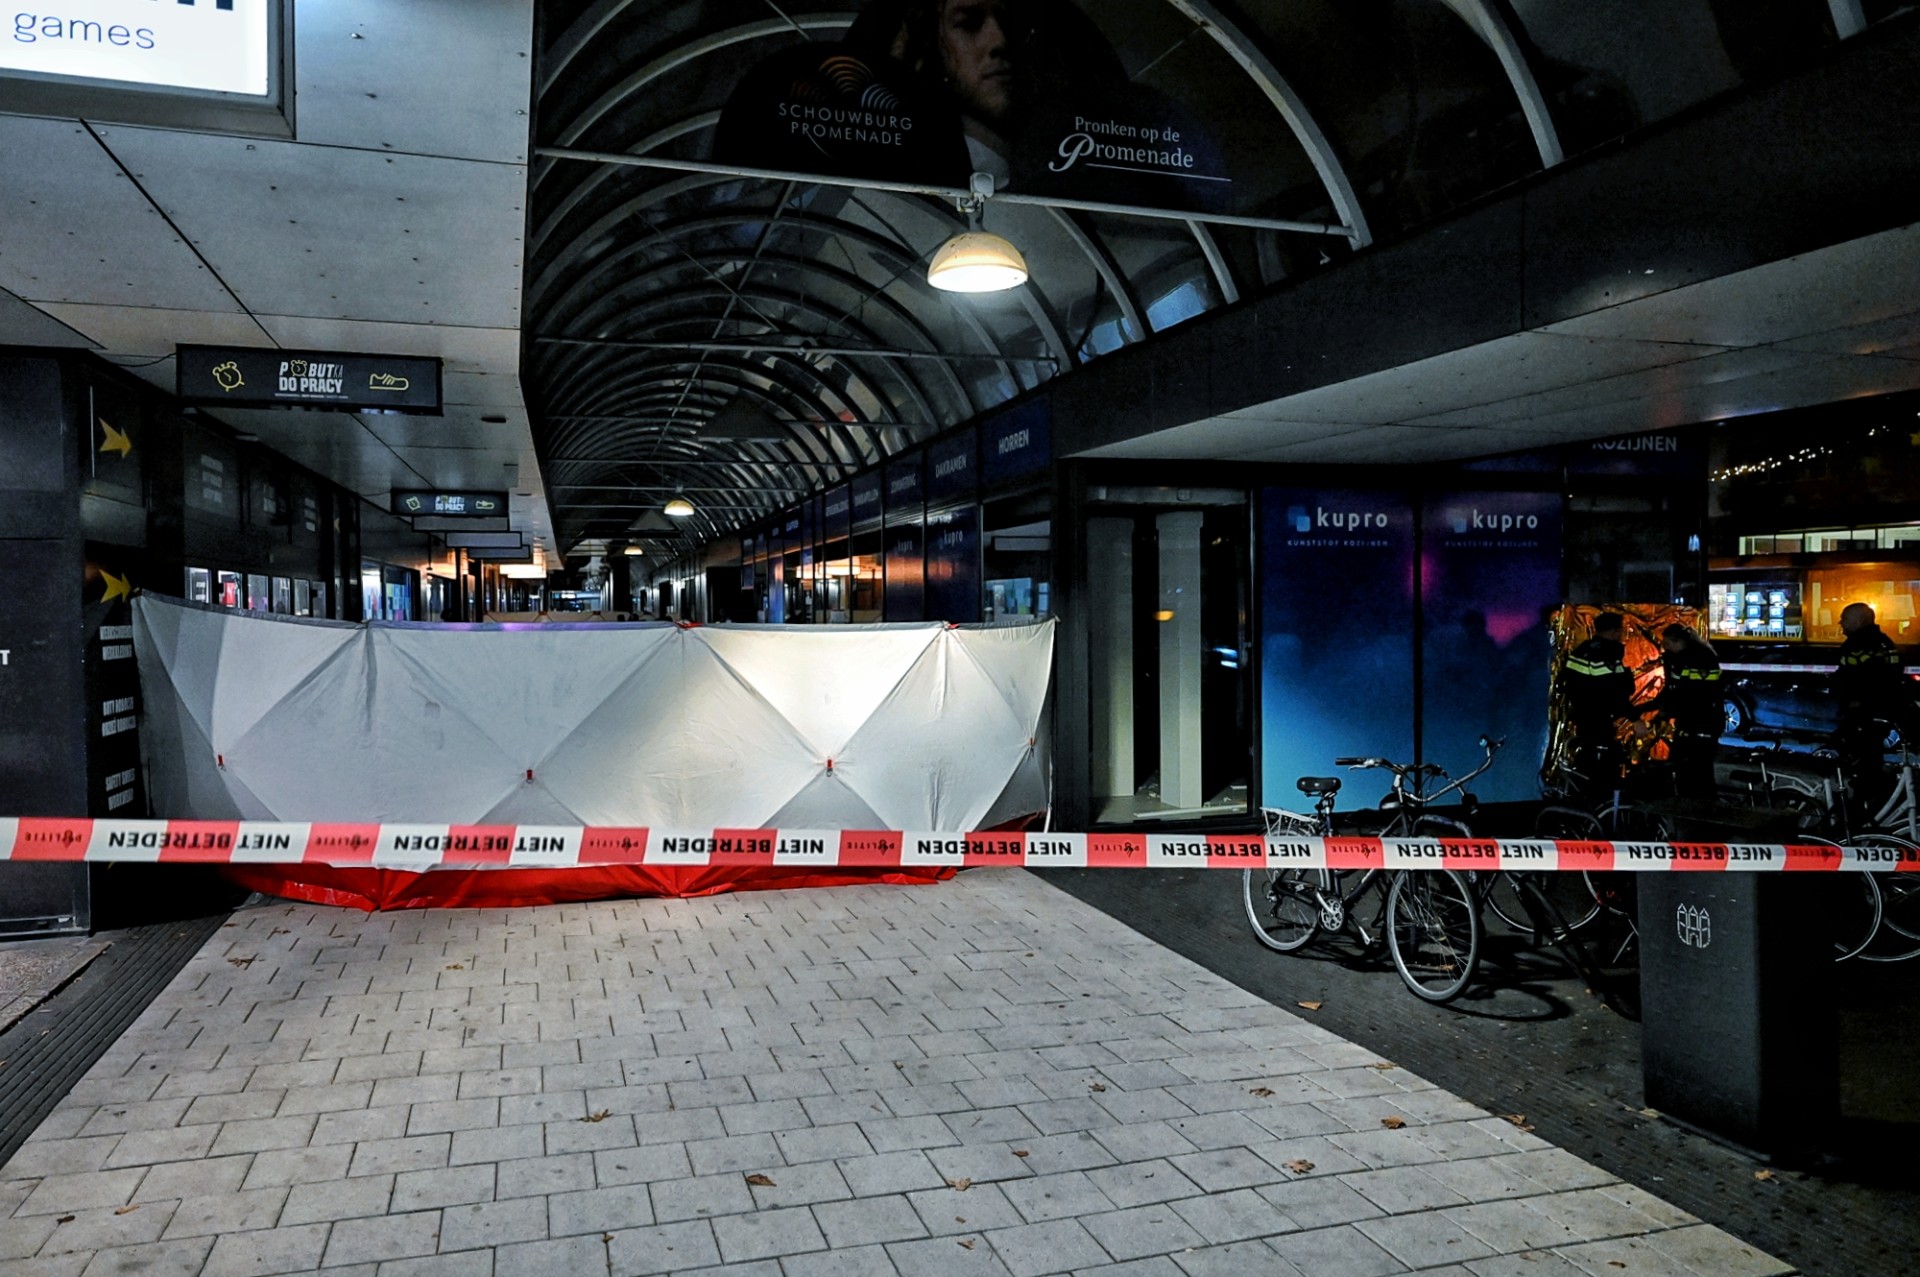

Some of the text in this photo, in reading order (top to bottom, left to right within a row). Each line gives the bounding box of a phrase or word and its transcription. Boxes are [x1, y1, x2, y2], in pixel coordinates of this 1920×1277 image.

[14, 13, 155, 50] games
[779, 102, 912, 131] SCHOUWBURG
[791, 121, 902, 146] PROMENADE
[1075, 116, 1180, 143] Pronken op de
[1048, 133, 1194, 172] Promenade
[279, 376, 343, 394] DO PRACY
[998, 429, 1029, 455] HORREN
[1317, 507, 1389, 531] kupro
[1473, 509, 1539, 532] kupro
[0, 649, 11, 666] T
[109, 832, 290, 850] NIET BETREDEN
[394, 835, 565, 852] NIET BETREDEN
[662, 838, 824, 854] NIET BETREDEN
[917, 840, 1072, 856] NIET BETREDEN
[1161, 842, 1311, 857] NIET BETREDEN
[1398, 844, 1544, 858] NIET BETREDEN
[1628, 845, 1772, 861] NIET BETREDEN
[1855, 848, 1920, 862] REDEN
